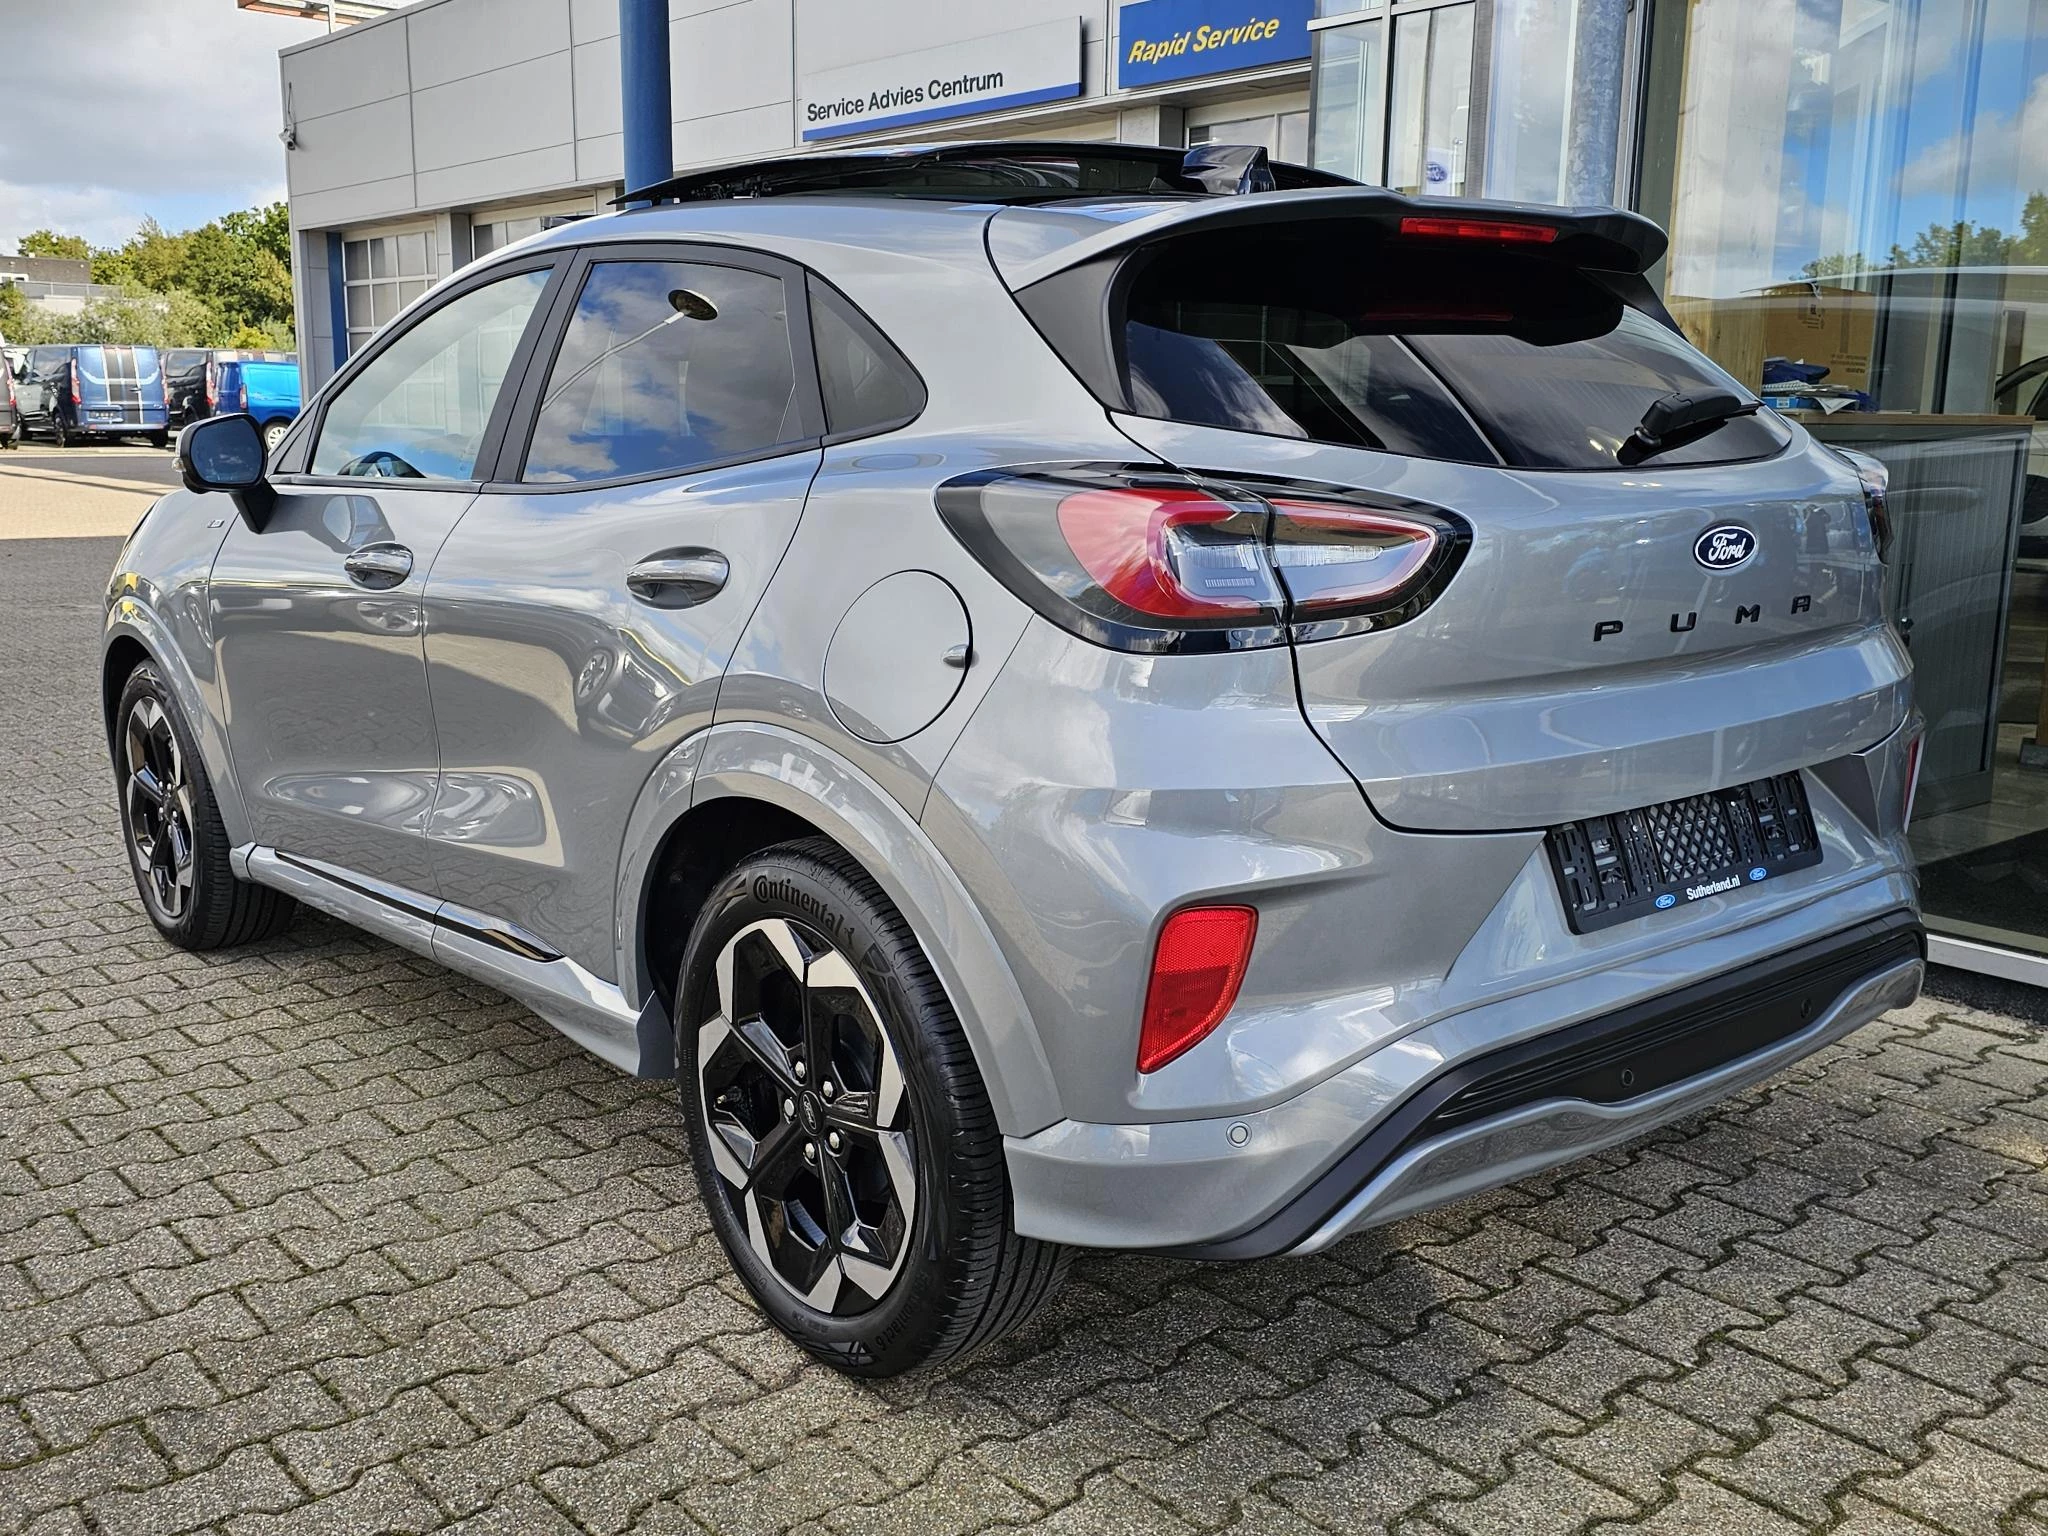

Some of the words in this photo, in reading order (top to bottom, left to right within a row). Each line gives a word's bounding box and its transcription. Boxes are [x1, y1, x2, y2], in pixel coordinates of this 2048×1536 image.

[1128, 32, 1191, 64] Rapid
[1193, 17, 1280, 52] Service
[807, 98, 864, 121] Service
[868, 86, 924, 111] Advies
[928, 72, 1003, 100] Centrum
[1593, 594, 1811, 642] PUMA
[753, 875, 845, 937] Continental
[1686, 874, 1741, 901] Sutherland.nl
